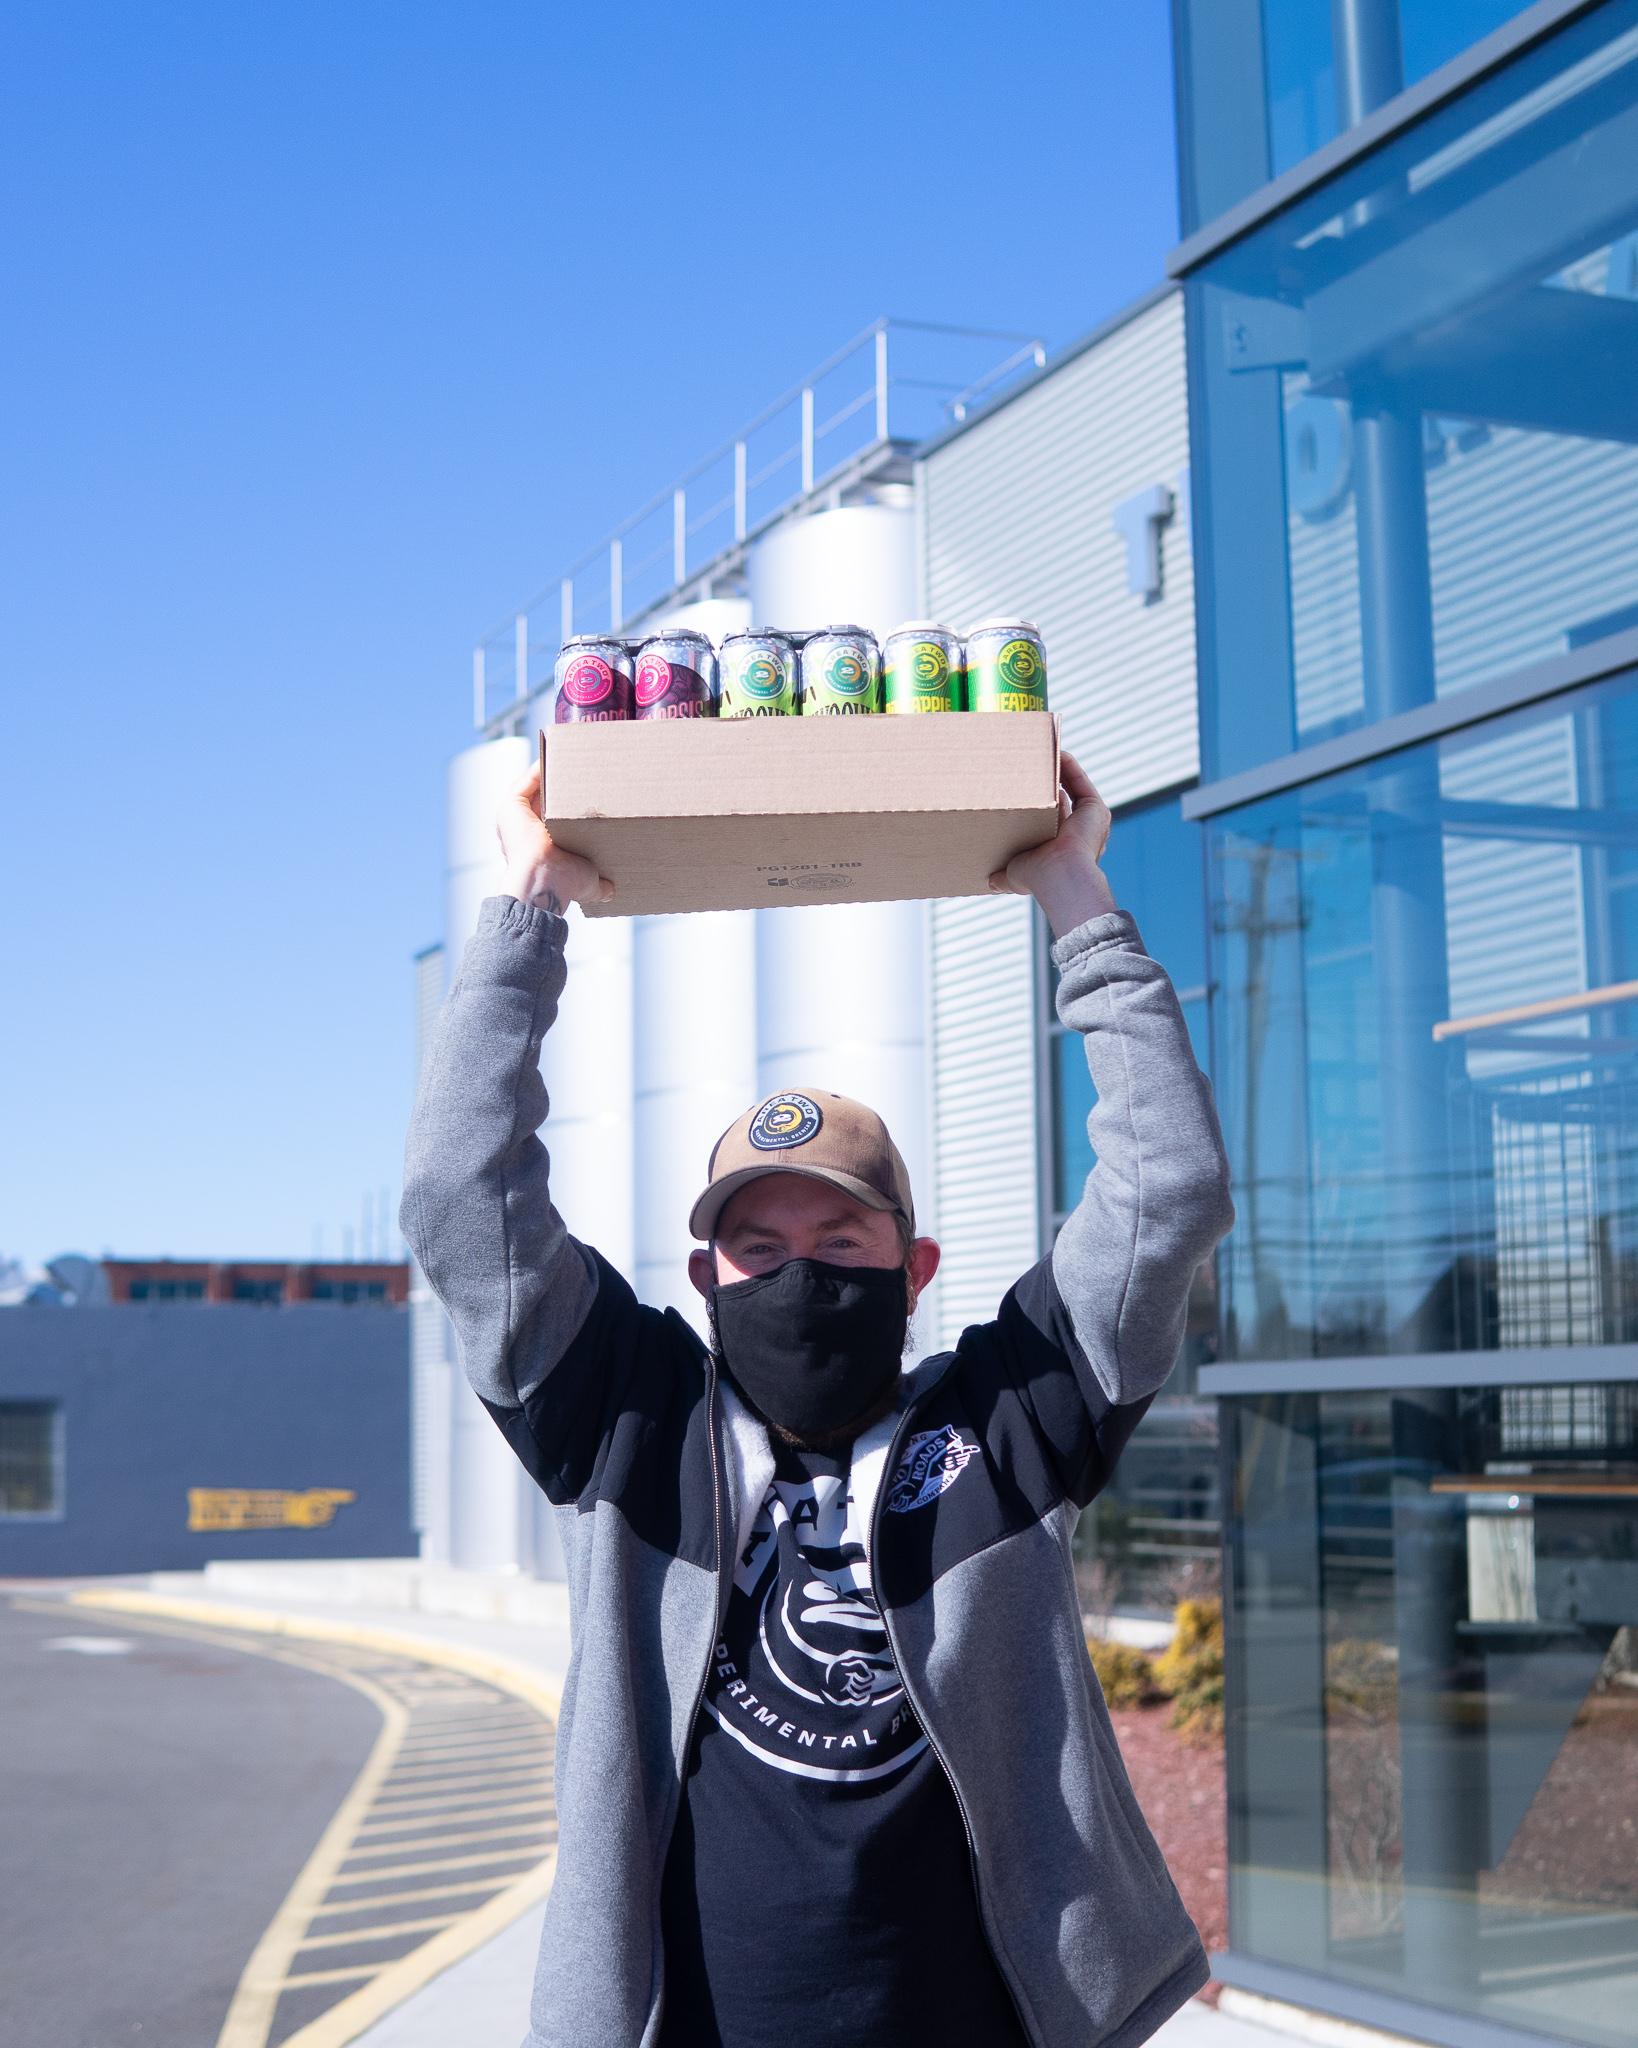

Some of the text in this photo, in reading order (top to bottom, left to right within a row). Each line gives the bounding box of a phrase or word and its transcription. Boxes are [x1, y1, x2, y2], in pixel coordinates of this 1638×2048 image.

[766, 654, 783, 672] TWO
[852, 650, 868, 669] TWO
[929, 647, 946, 665] TWO
[591, 659, 609, 677] TWO
[757, 1096, 815, 1123] AREA TWO
[911, 1437, 946, 1480] ROADS
[916, 1474, 955, 1505] COMPANY
[713, 1642, 878, 1749] PERIMENTAL
